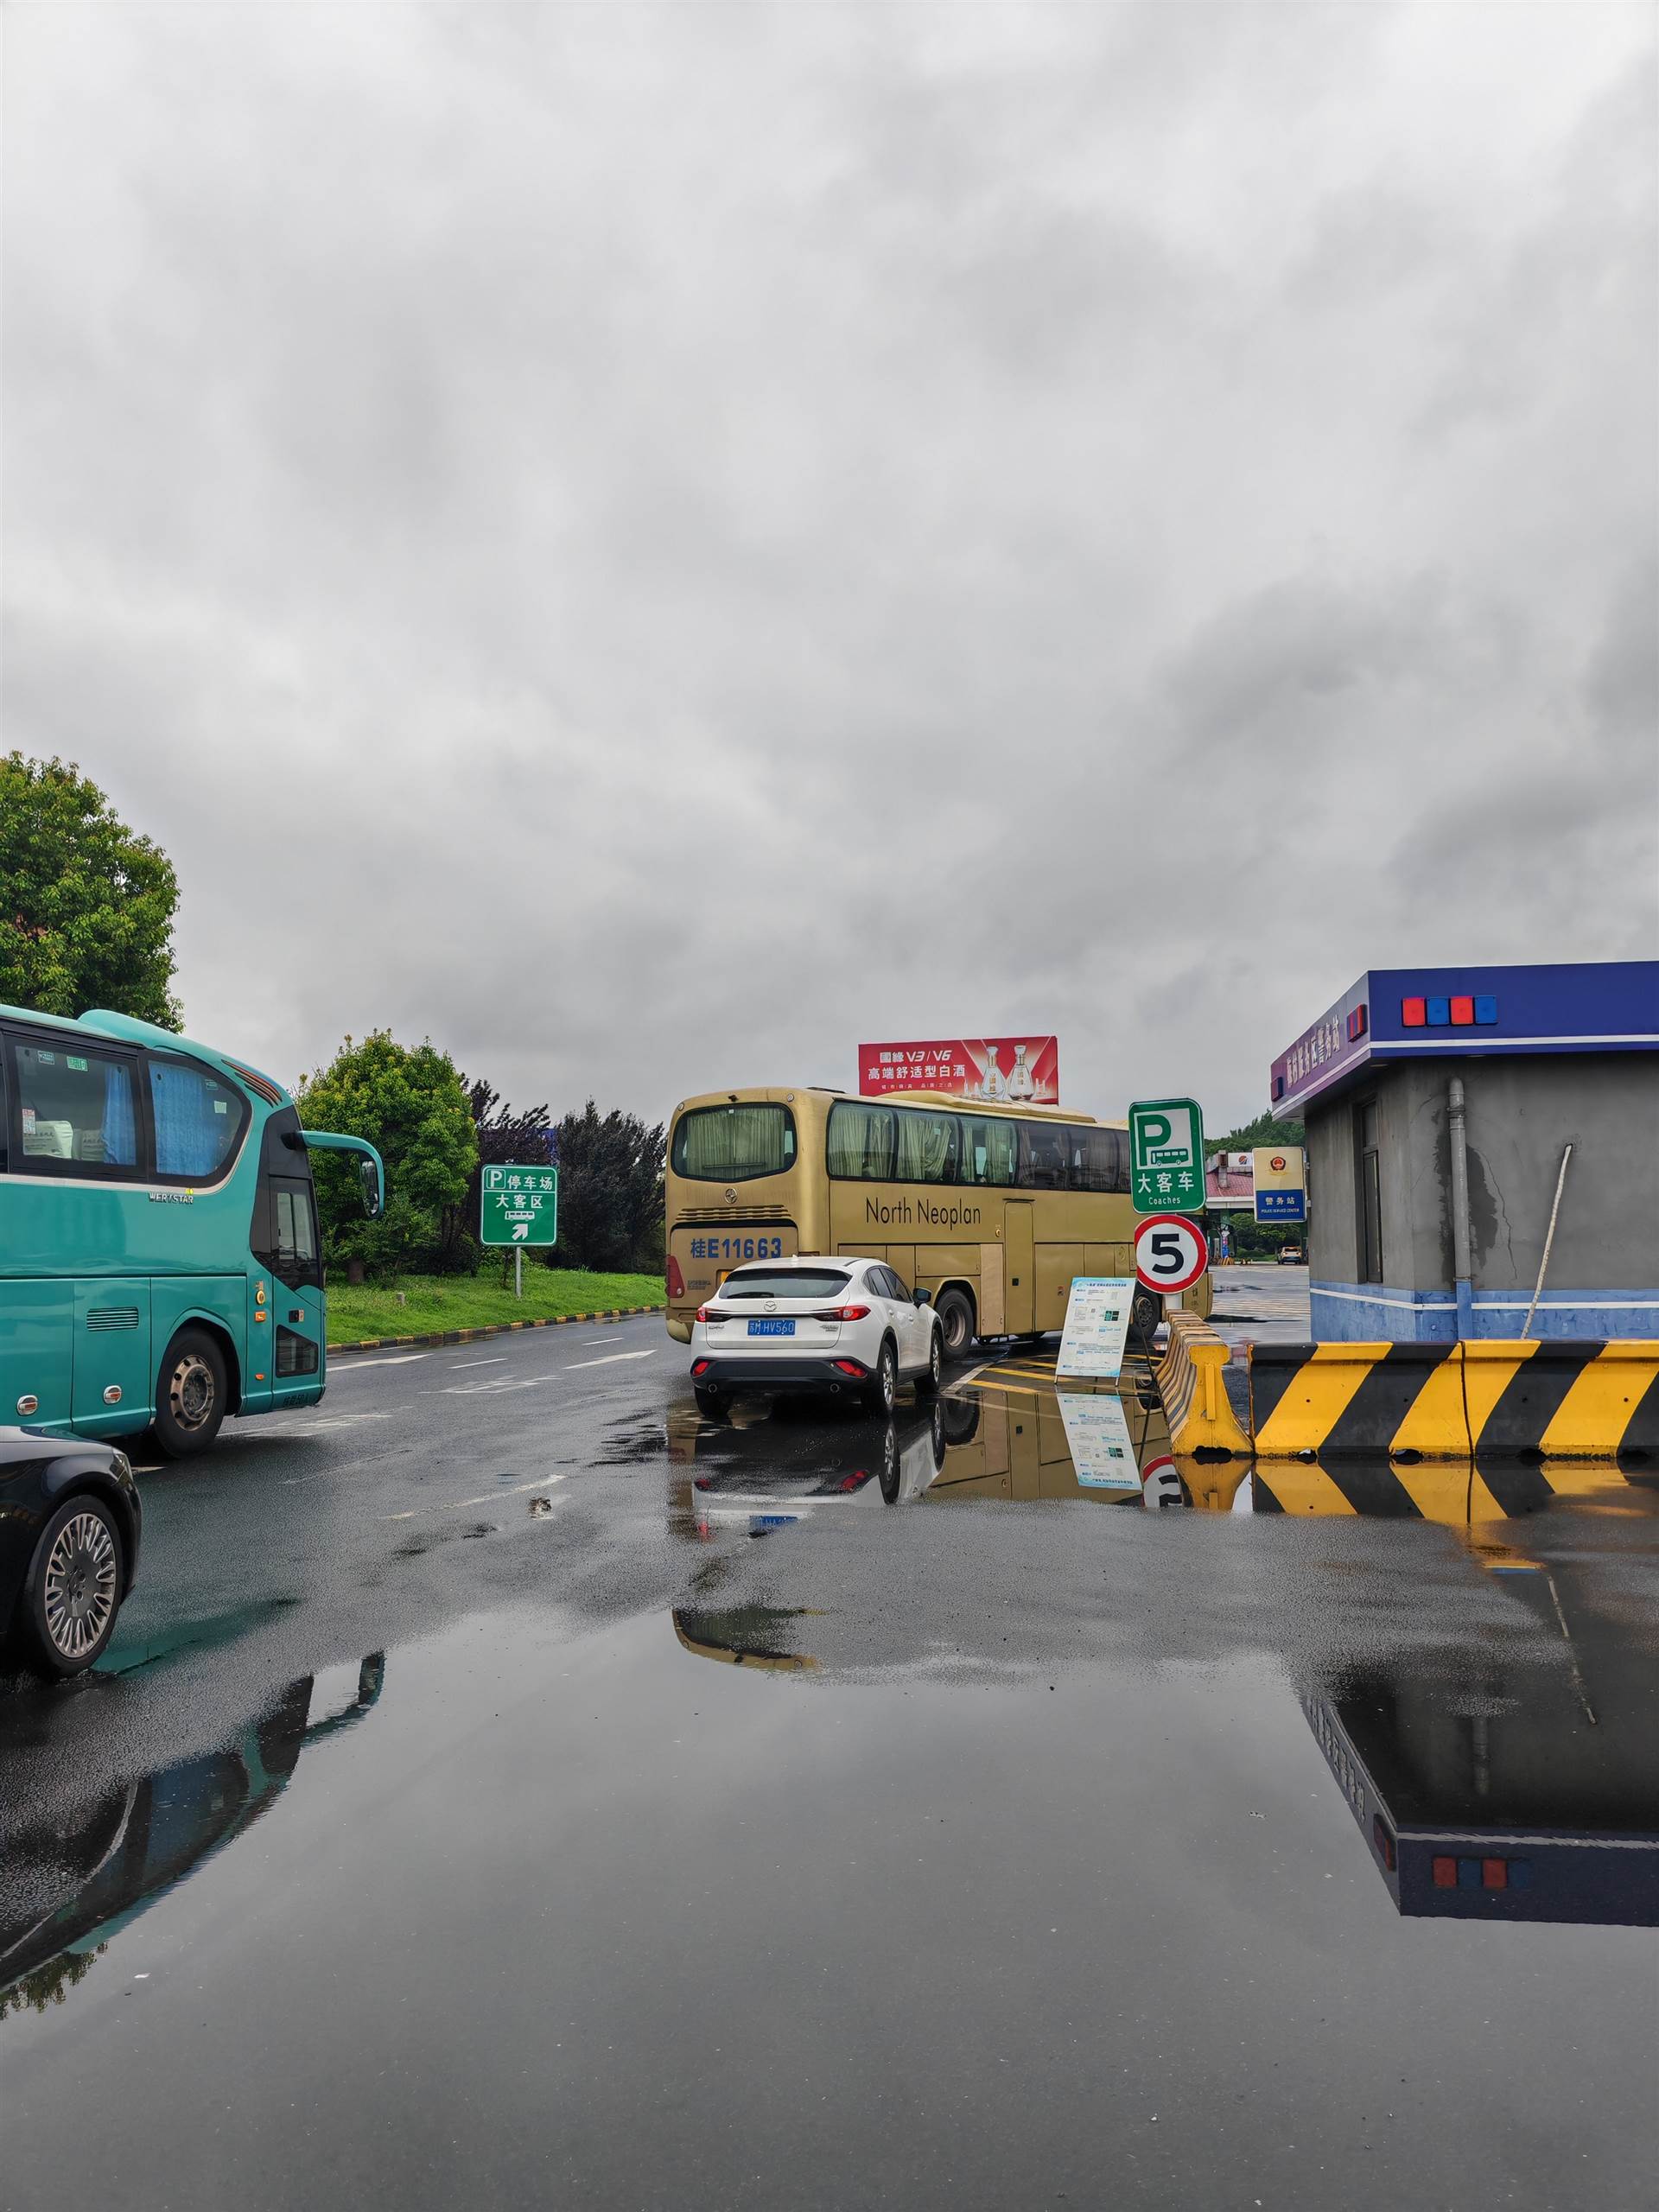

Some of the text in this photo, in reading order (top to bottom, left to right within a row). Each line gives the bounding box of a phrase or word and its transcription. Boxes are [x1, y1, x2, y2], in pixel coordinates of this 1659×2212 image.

[868, 1064, 966, 1080] 高端舒适型白酒
[507, 1174, 553, 1191] 停车场
[1137, 1171, 1195, 1195] 大客车
[495, 1193, 543, 1209] 大客区
[1148, 1196, 1181, 1205] Coaches
[1265, 1197, 1295, 1205] 警务站
[866, 1196, 981, 1231] North Neoplan
[690, 1236, 782, 1259] 桂E11663
[1151, 1233, 1185, 1275] 5
